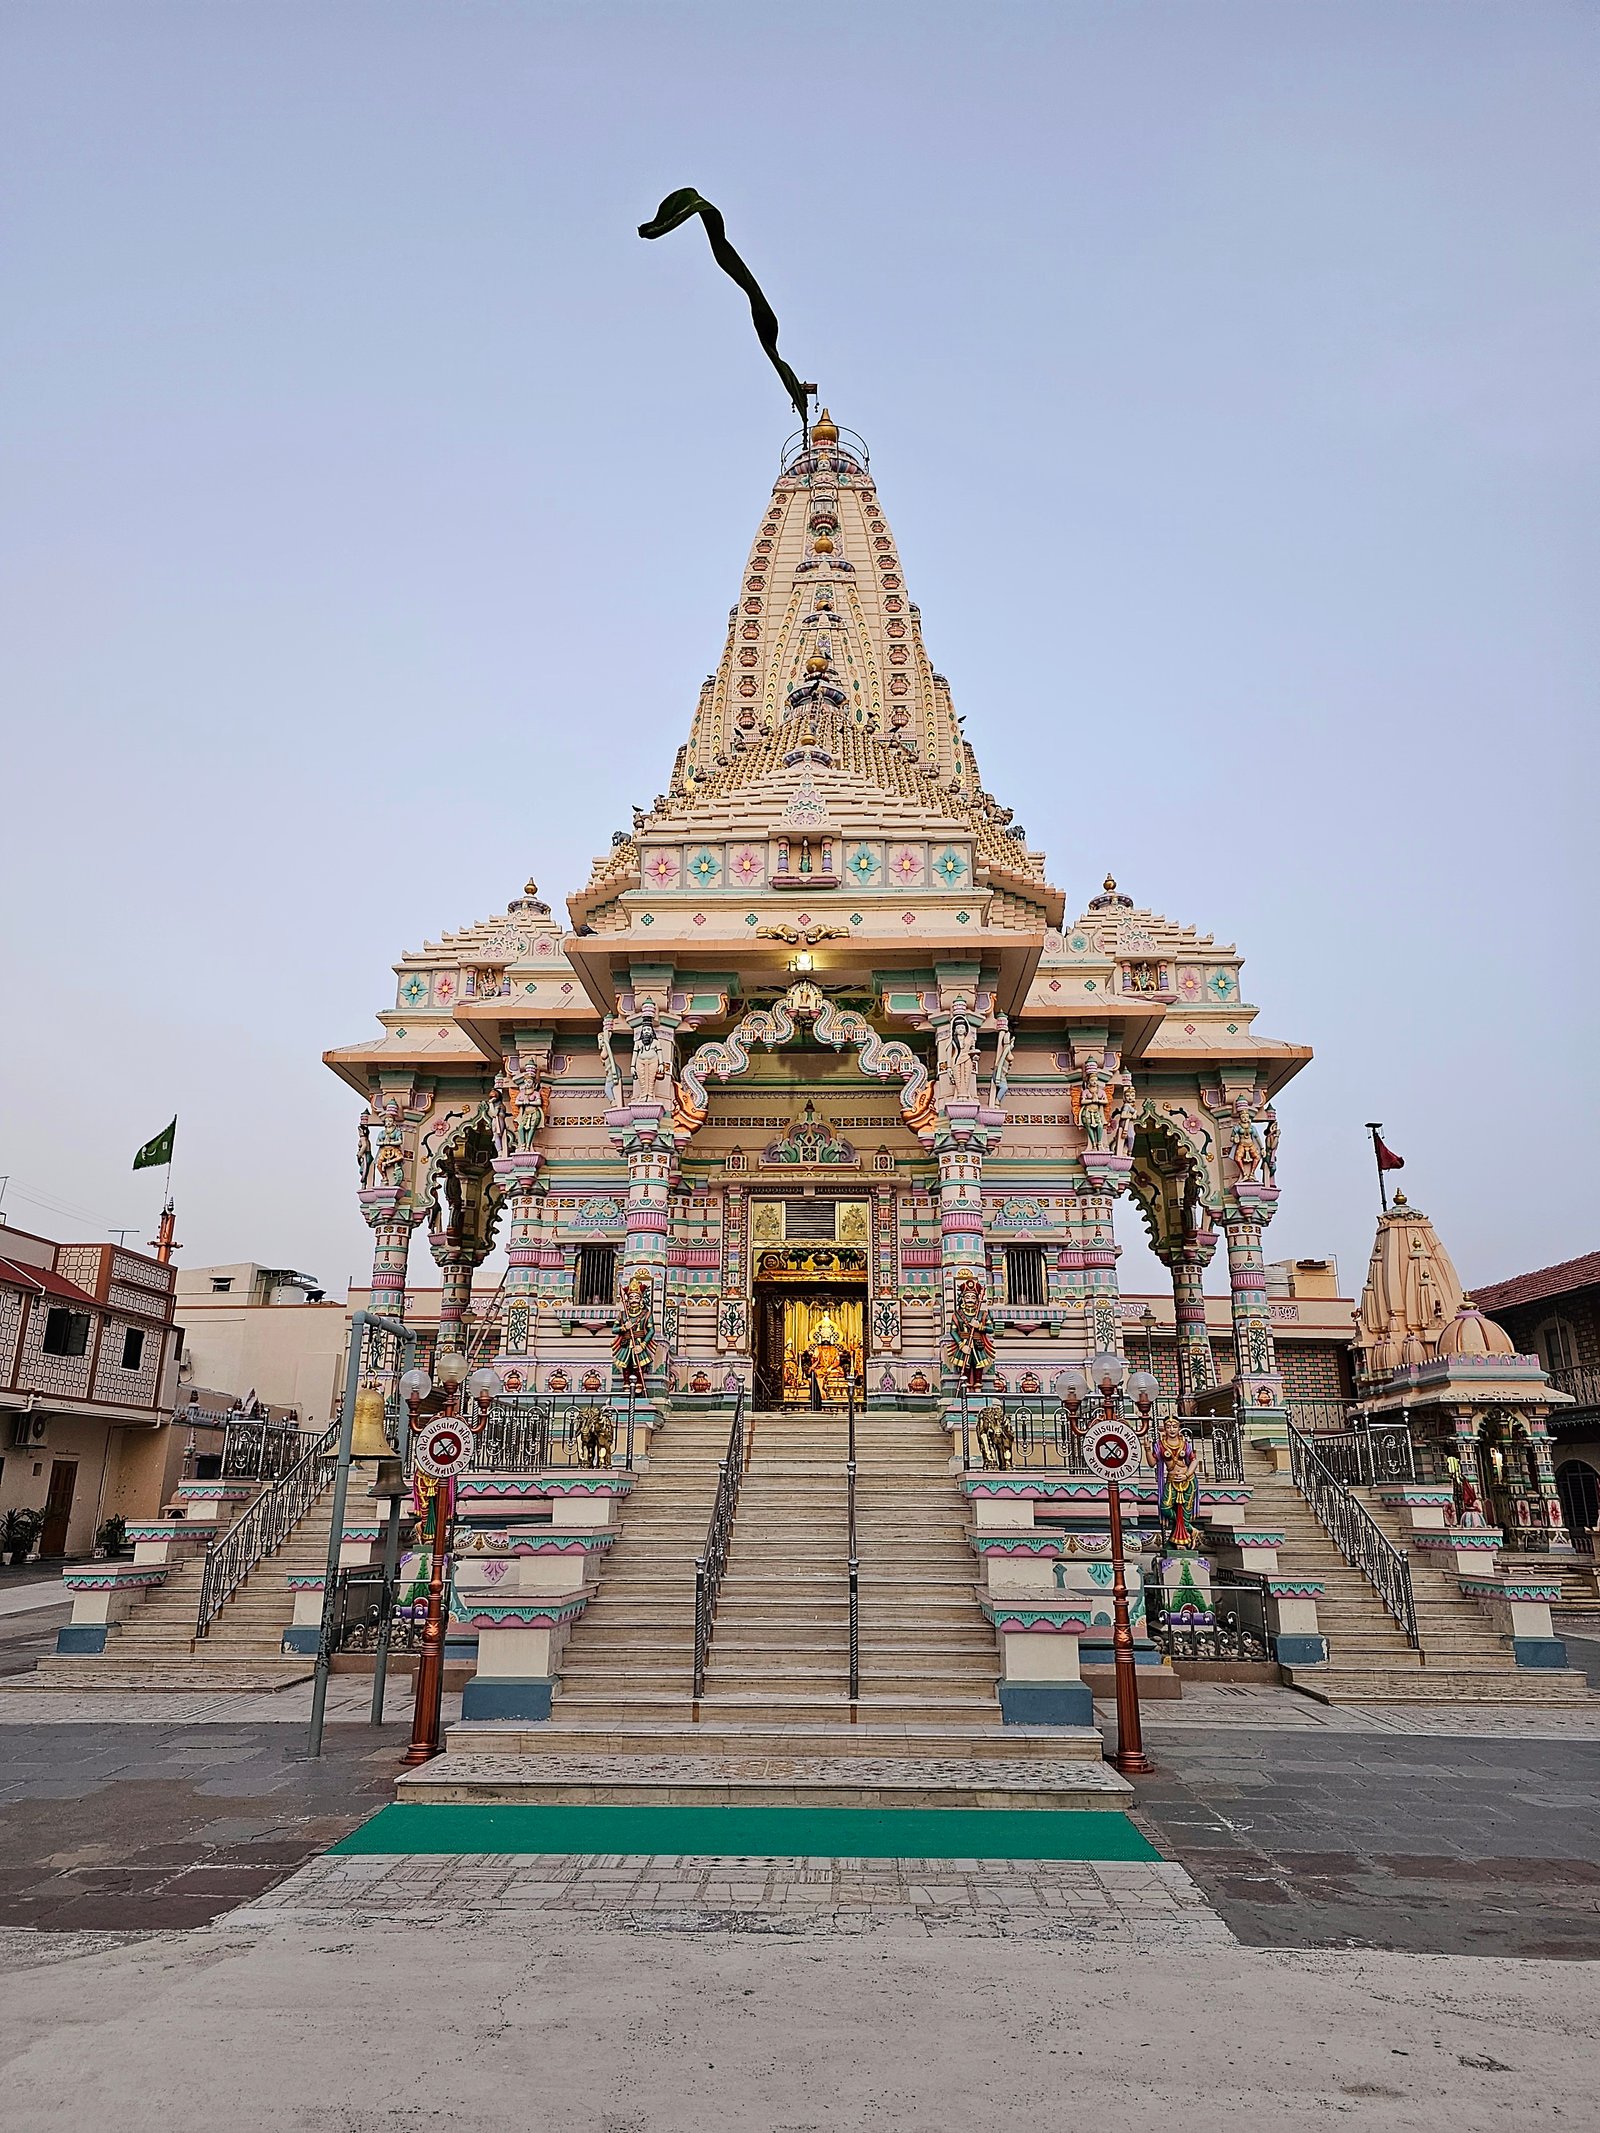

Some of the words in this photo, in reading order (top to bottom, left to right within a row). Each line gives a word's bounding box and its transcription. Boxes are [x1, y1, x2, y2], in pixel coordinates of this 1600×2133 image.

[417, 1435, 430, 1451] ફોટો
[428, 1421, 459, 1435] પાડવાની
[459, 1427, 471, 1445] મંદિર
[1083, 1435, 1096, 1452] ફોટો
[1092, 1424, 1124, 1436] પાડવાની
[1124, 1431, 1138, 1450] મંદિર
[421, 1454, 435, 1471] સખત
[435, 1464, 455, 1475] મનાઈ
[1088, 1456, 1103, 1474] સખત
[1104, 1466, 1125, 1479] મનાઈ
